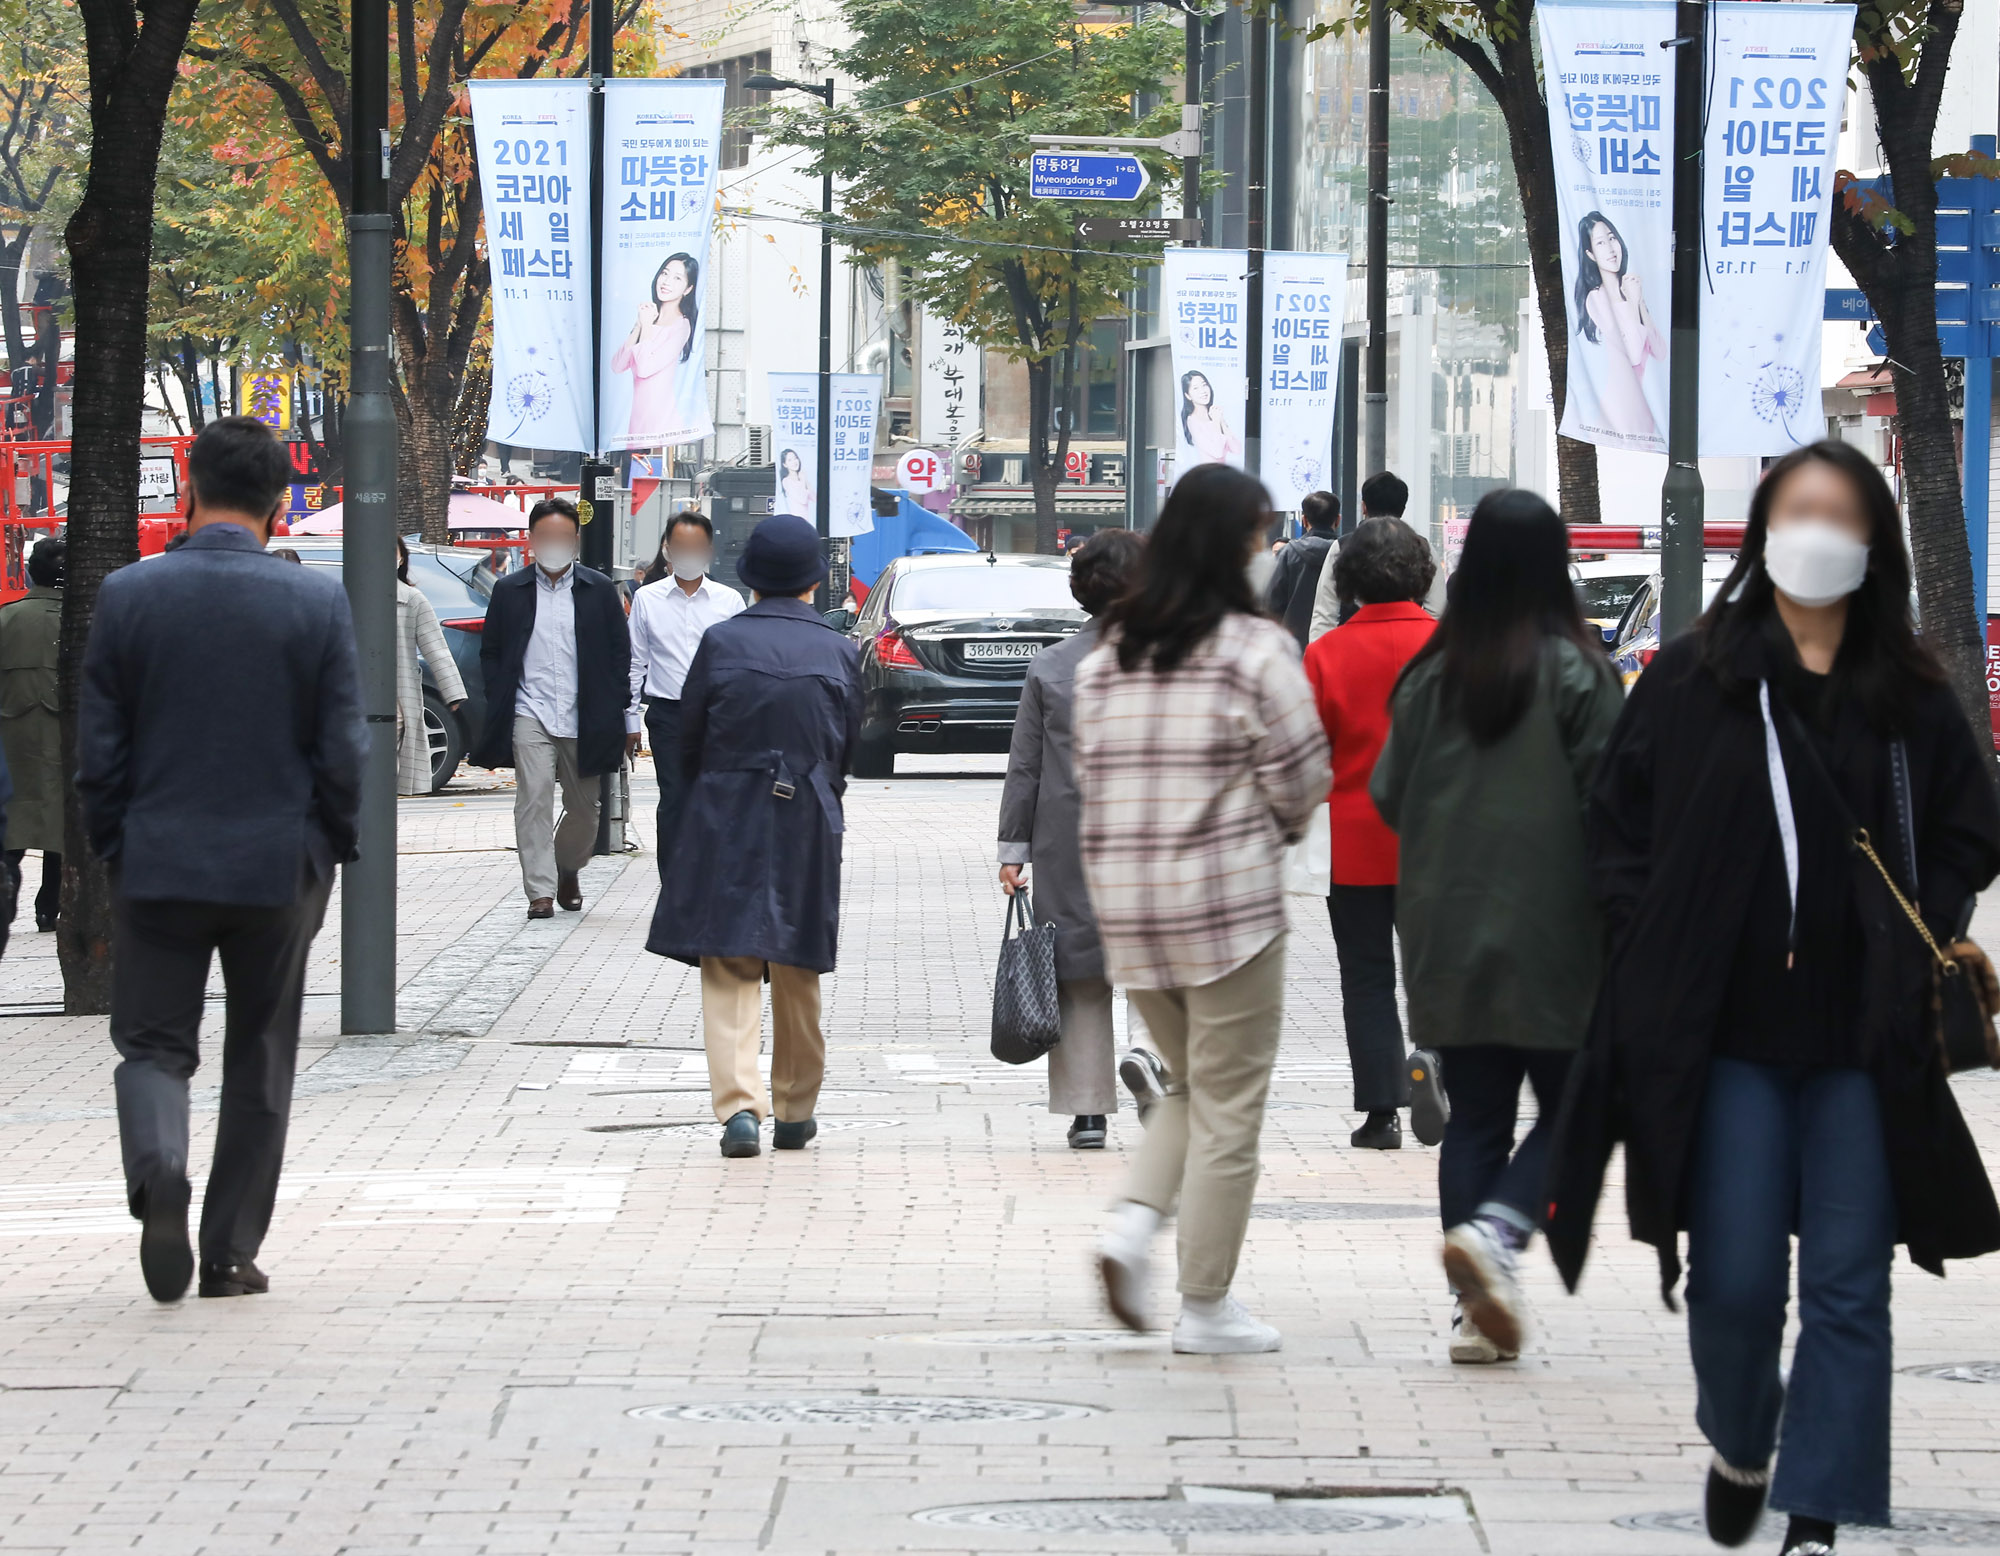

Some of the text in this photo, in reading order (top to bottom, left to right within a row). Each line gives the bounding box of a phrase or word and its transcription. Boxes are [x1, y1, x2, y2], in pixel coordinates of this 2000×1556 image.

[493, 139, 567, 166] 2021
[621, 138, 709, 149] 국민 모두에게 힘이 되는
[621, 154, 709, 187] 따뜻한
[1035, 158, 1080, 173] 명동8길
[496, 174, 572, 206] 코리아
[1035, 174, 1118, 187] Myeongdong 8-gil
[619, 190, 676, 222] 소비
[499, 211, 569, 243] 세 일
[501, 248, 573, 280] 페스타
[503, 287, 574, 302] 11.1 11.15
[906, 458, 937, 488] 약
[354, 492, 387, 504] 서울중구
[969, 645, 1003, 657] 386머
